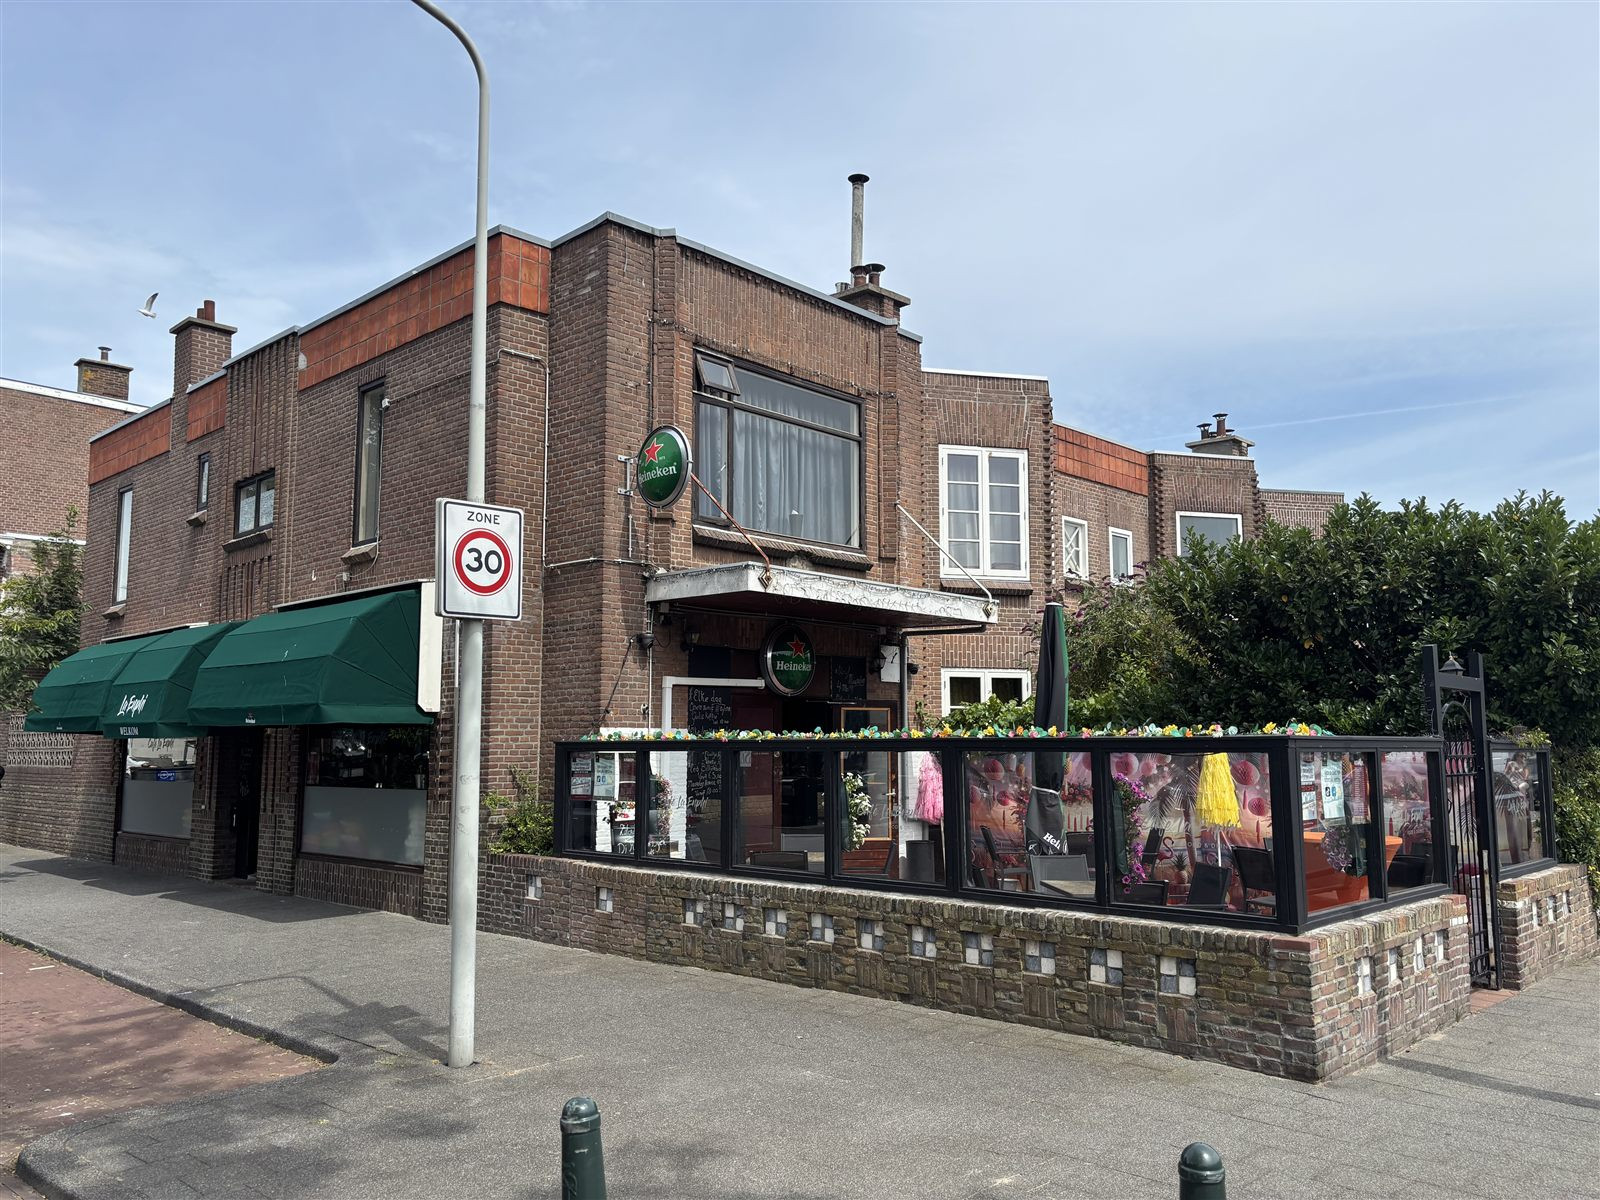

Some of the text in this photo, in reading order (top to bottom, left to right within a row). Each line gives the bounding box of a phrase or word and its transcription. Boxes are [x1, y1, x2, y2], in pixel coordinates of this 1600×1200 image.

[639, 465, 677, 484] eineken
[467, 511, 500, 525] ZONE
[465, 547, 502, 575] 30
[120, 726, 139, 736] WELKOM
